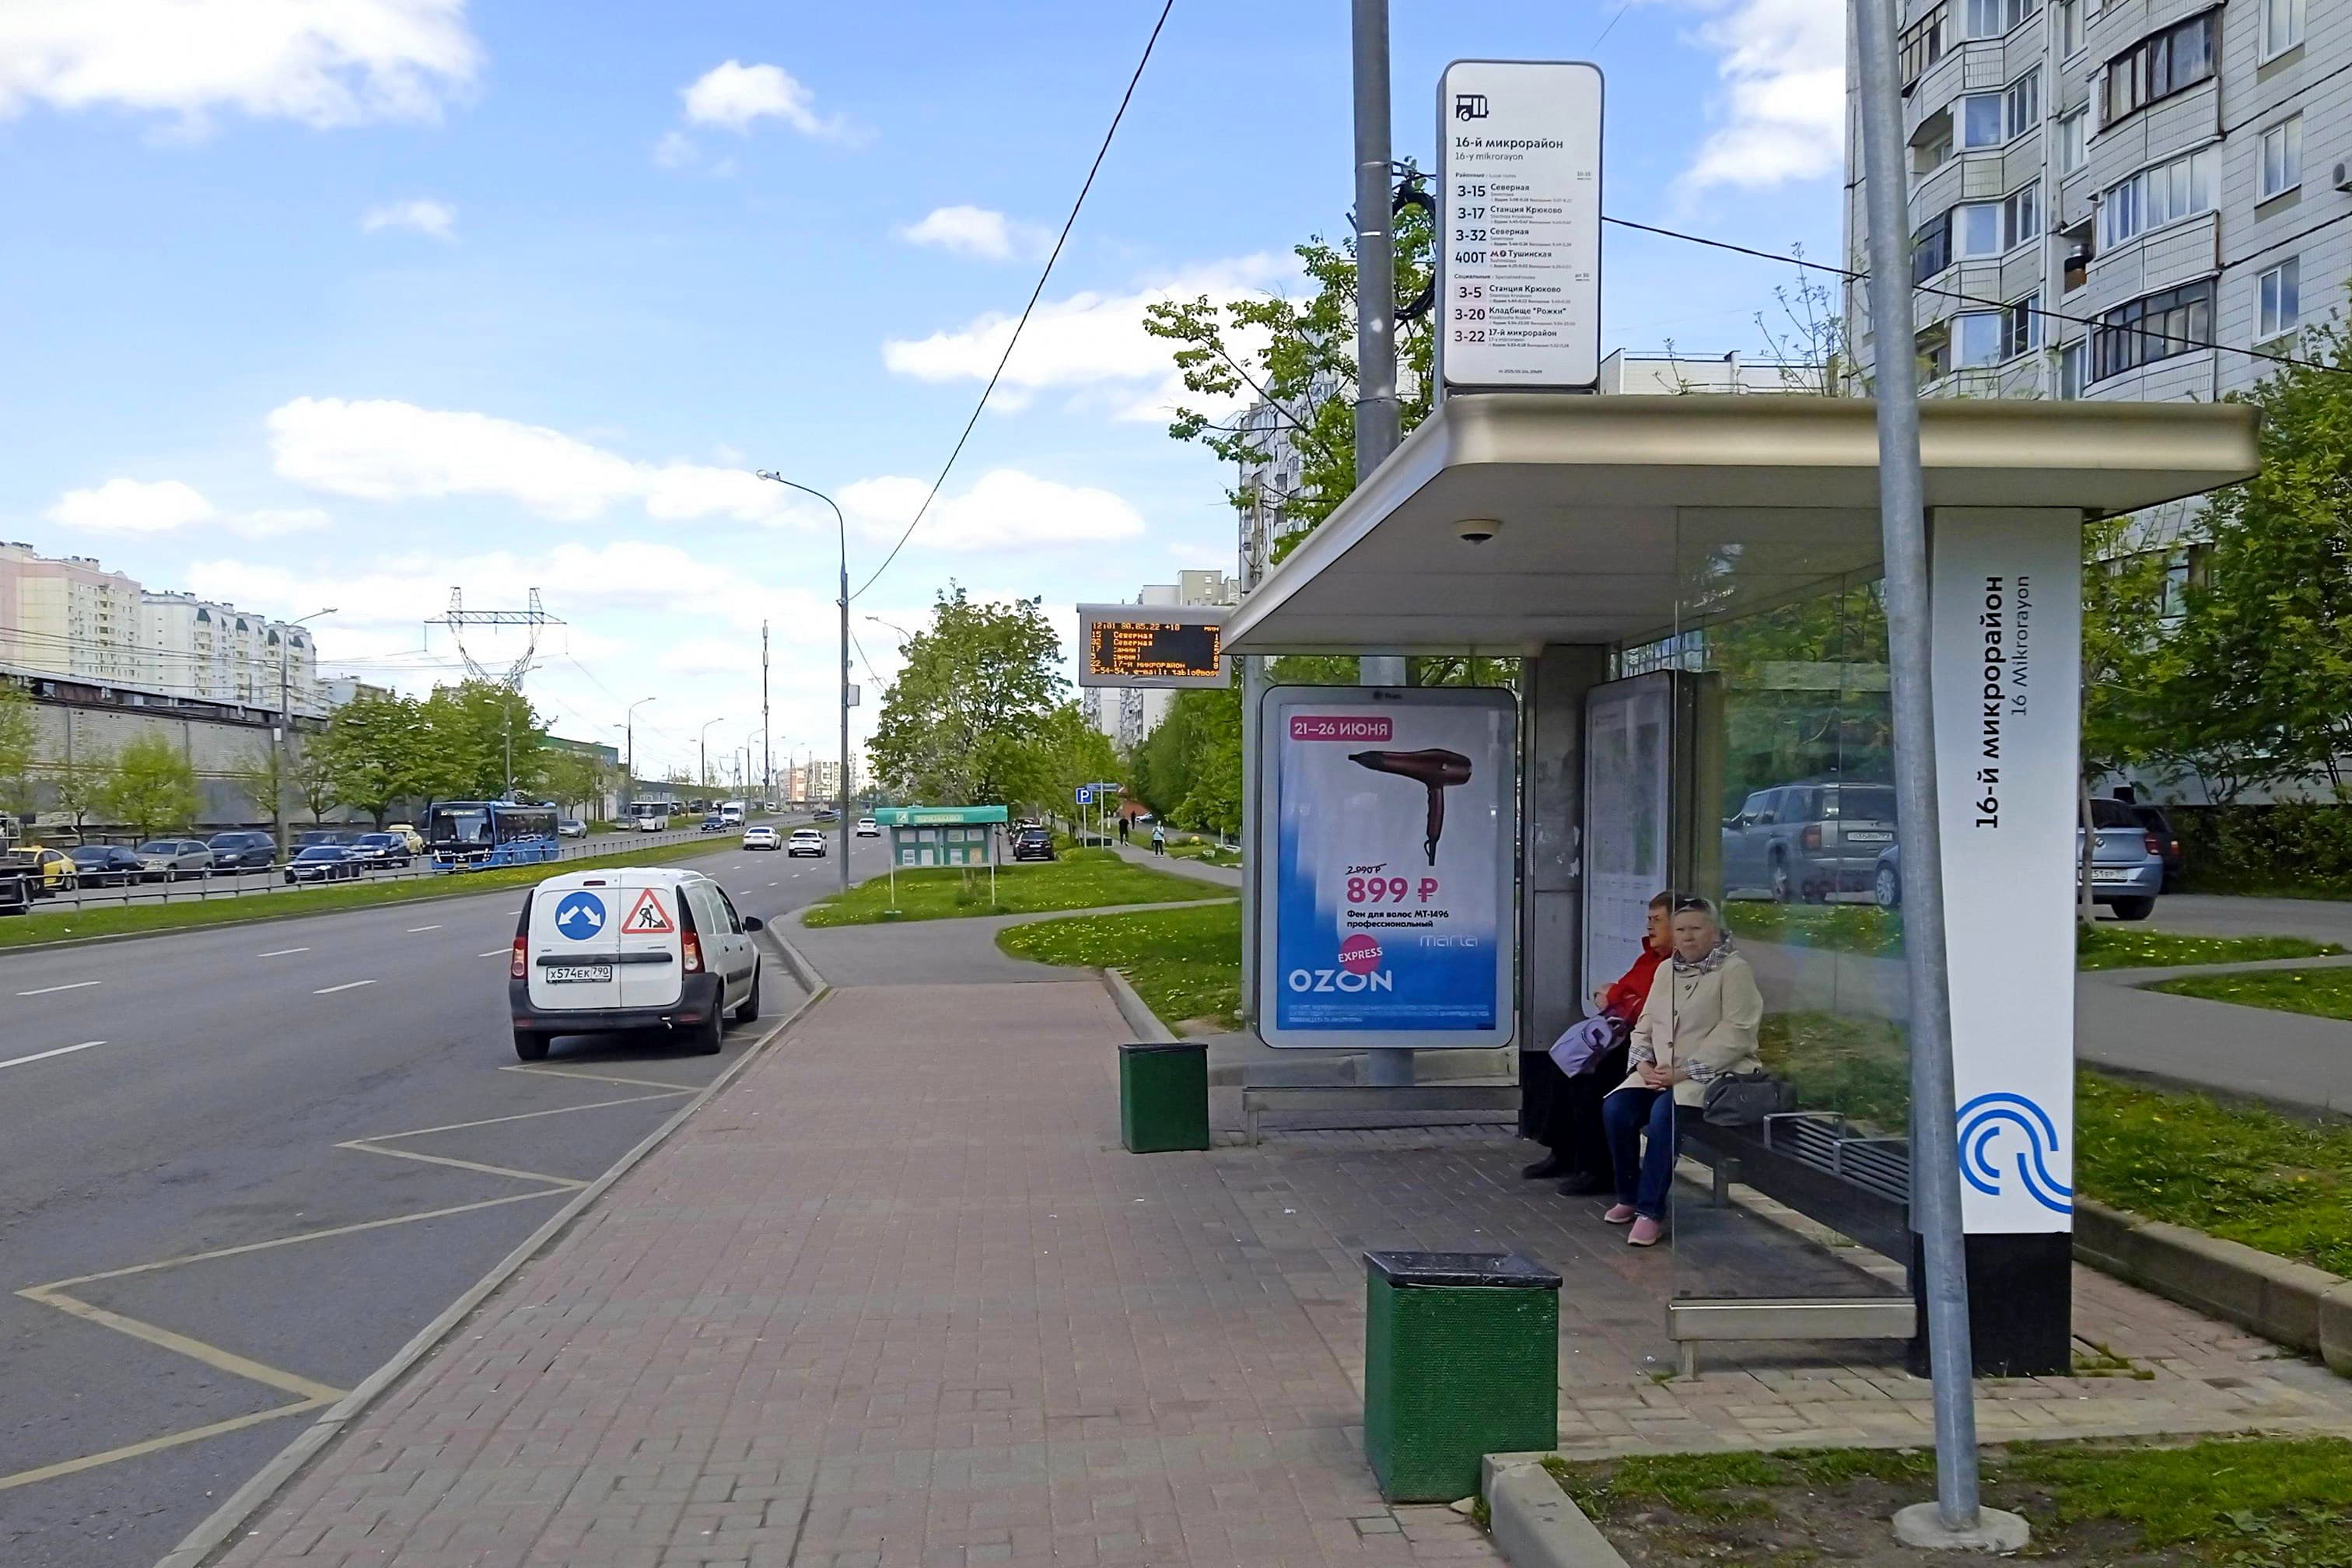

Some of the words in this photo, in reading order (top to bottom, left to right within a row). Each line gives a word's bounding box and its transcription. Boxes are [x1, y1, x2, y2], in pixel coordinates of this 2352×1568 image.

[1456, 137, 1482, 148] 16-й
[1486, 138, 1563, 150] микрорайон
[1456, 152, 1474, 161] 16-y
[1476, 152, 1524, 161] mikrorayon
[1490, 183, 1530, 191] Северная
[1490, 205, 1524, 215] Станция
[1490, 227, 1529, 236] Северная
[1508, 250, 1552, 258] Тушинская
[1524, 285, 1561, 293] Крюково
[2012, 576, 2032, 688] Mikrorayon
[1979, 576, 2007, 759] микрорайон
[2011, 695, 2028, 716] 16
[1339, 723, 1388, 736] ИЮНЯ
[1976, 768, 1999, 828] 16-й
[1347, 877, 1409, 903] 899
[1347, 920, 1433, 929] профессиональный
[1338, 947, 1383, 963] EXPRESS
[1289, 969, 1392, 992] OZON
